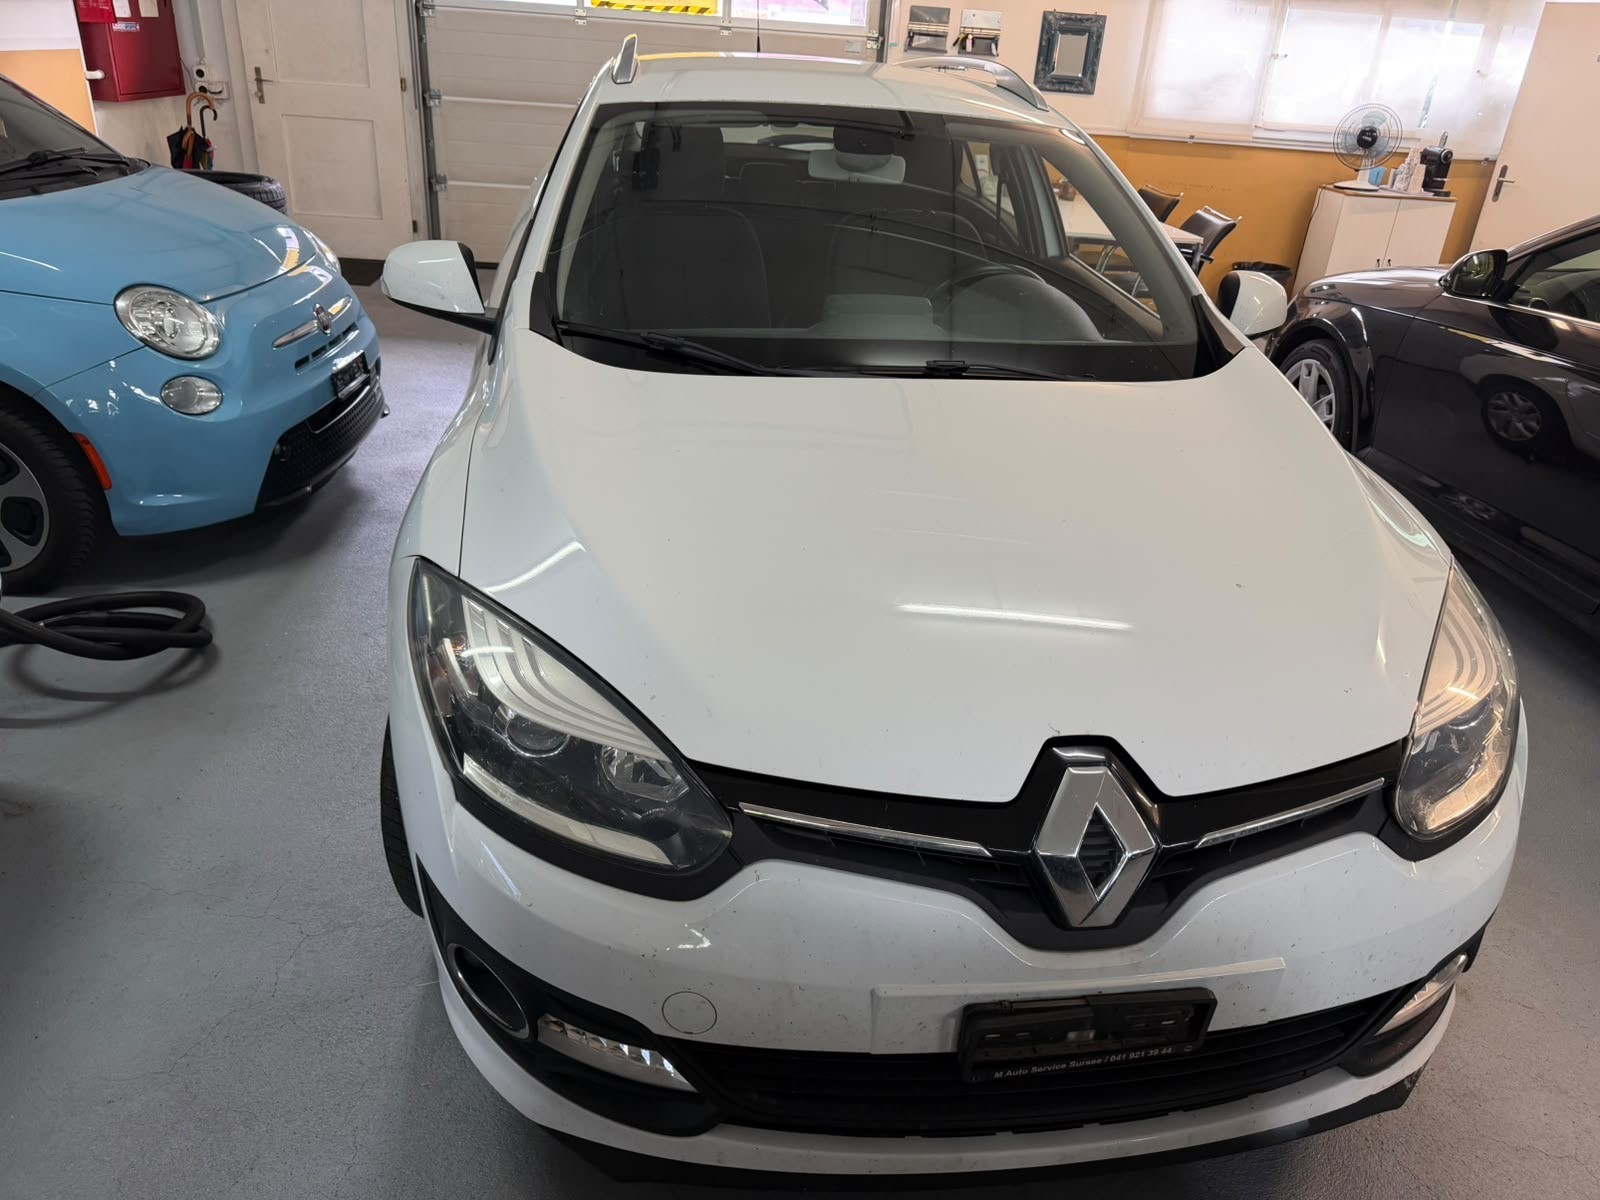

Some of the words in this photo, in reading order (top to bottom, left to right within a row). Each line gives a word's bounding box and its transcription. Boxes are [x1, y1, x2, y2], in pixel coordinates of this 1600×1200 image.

[993, 1071, 1003, 1079] M
[1004, 1069, 1028, 1078] Auto
[1030, 1063, 1067, 1073] Service
[1069, 1058, 1102, 1068] Sursee
[1110, 1053, 1127, 1062] 041
[1129, 1050, 1145, 1060] 921
[1146, 1048, 1159, 1057] 39
